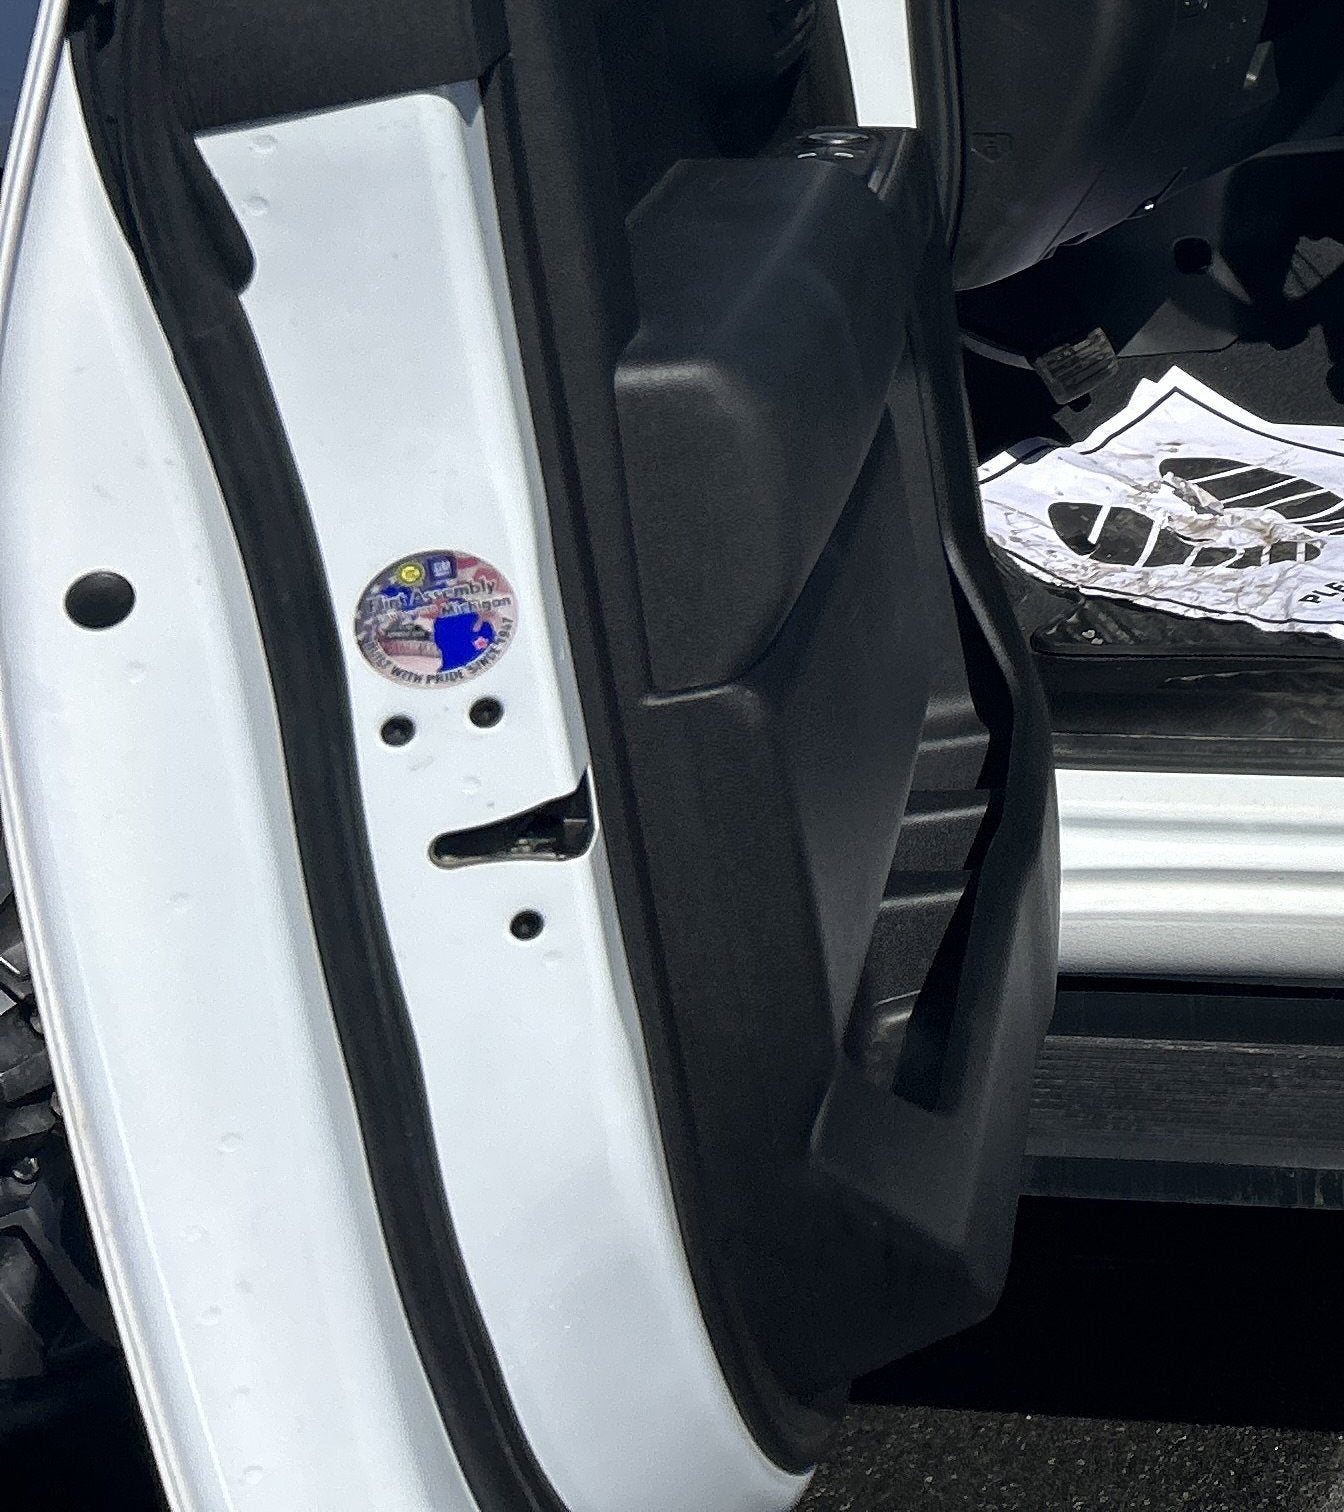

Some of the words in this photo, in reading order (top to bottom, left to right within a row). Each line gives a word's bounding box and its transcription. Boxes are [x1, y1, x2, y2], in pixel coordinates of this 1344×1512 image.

[412, 578, 496, 604] Assembly
[441, 597, 511, 615] Michigan
[391, 666, 423, 683] WITH
[426, 670, 464, 685] PRIDE
